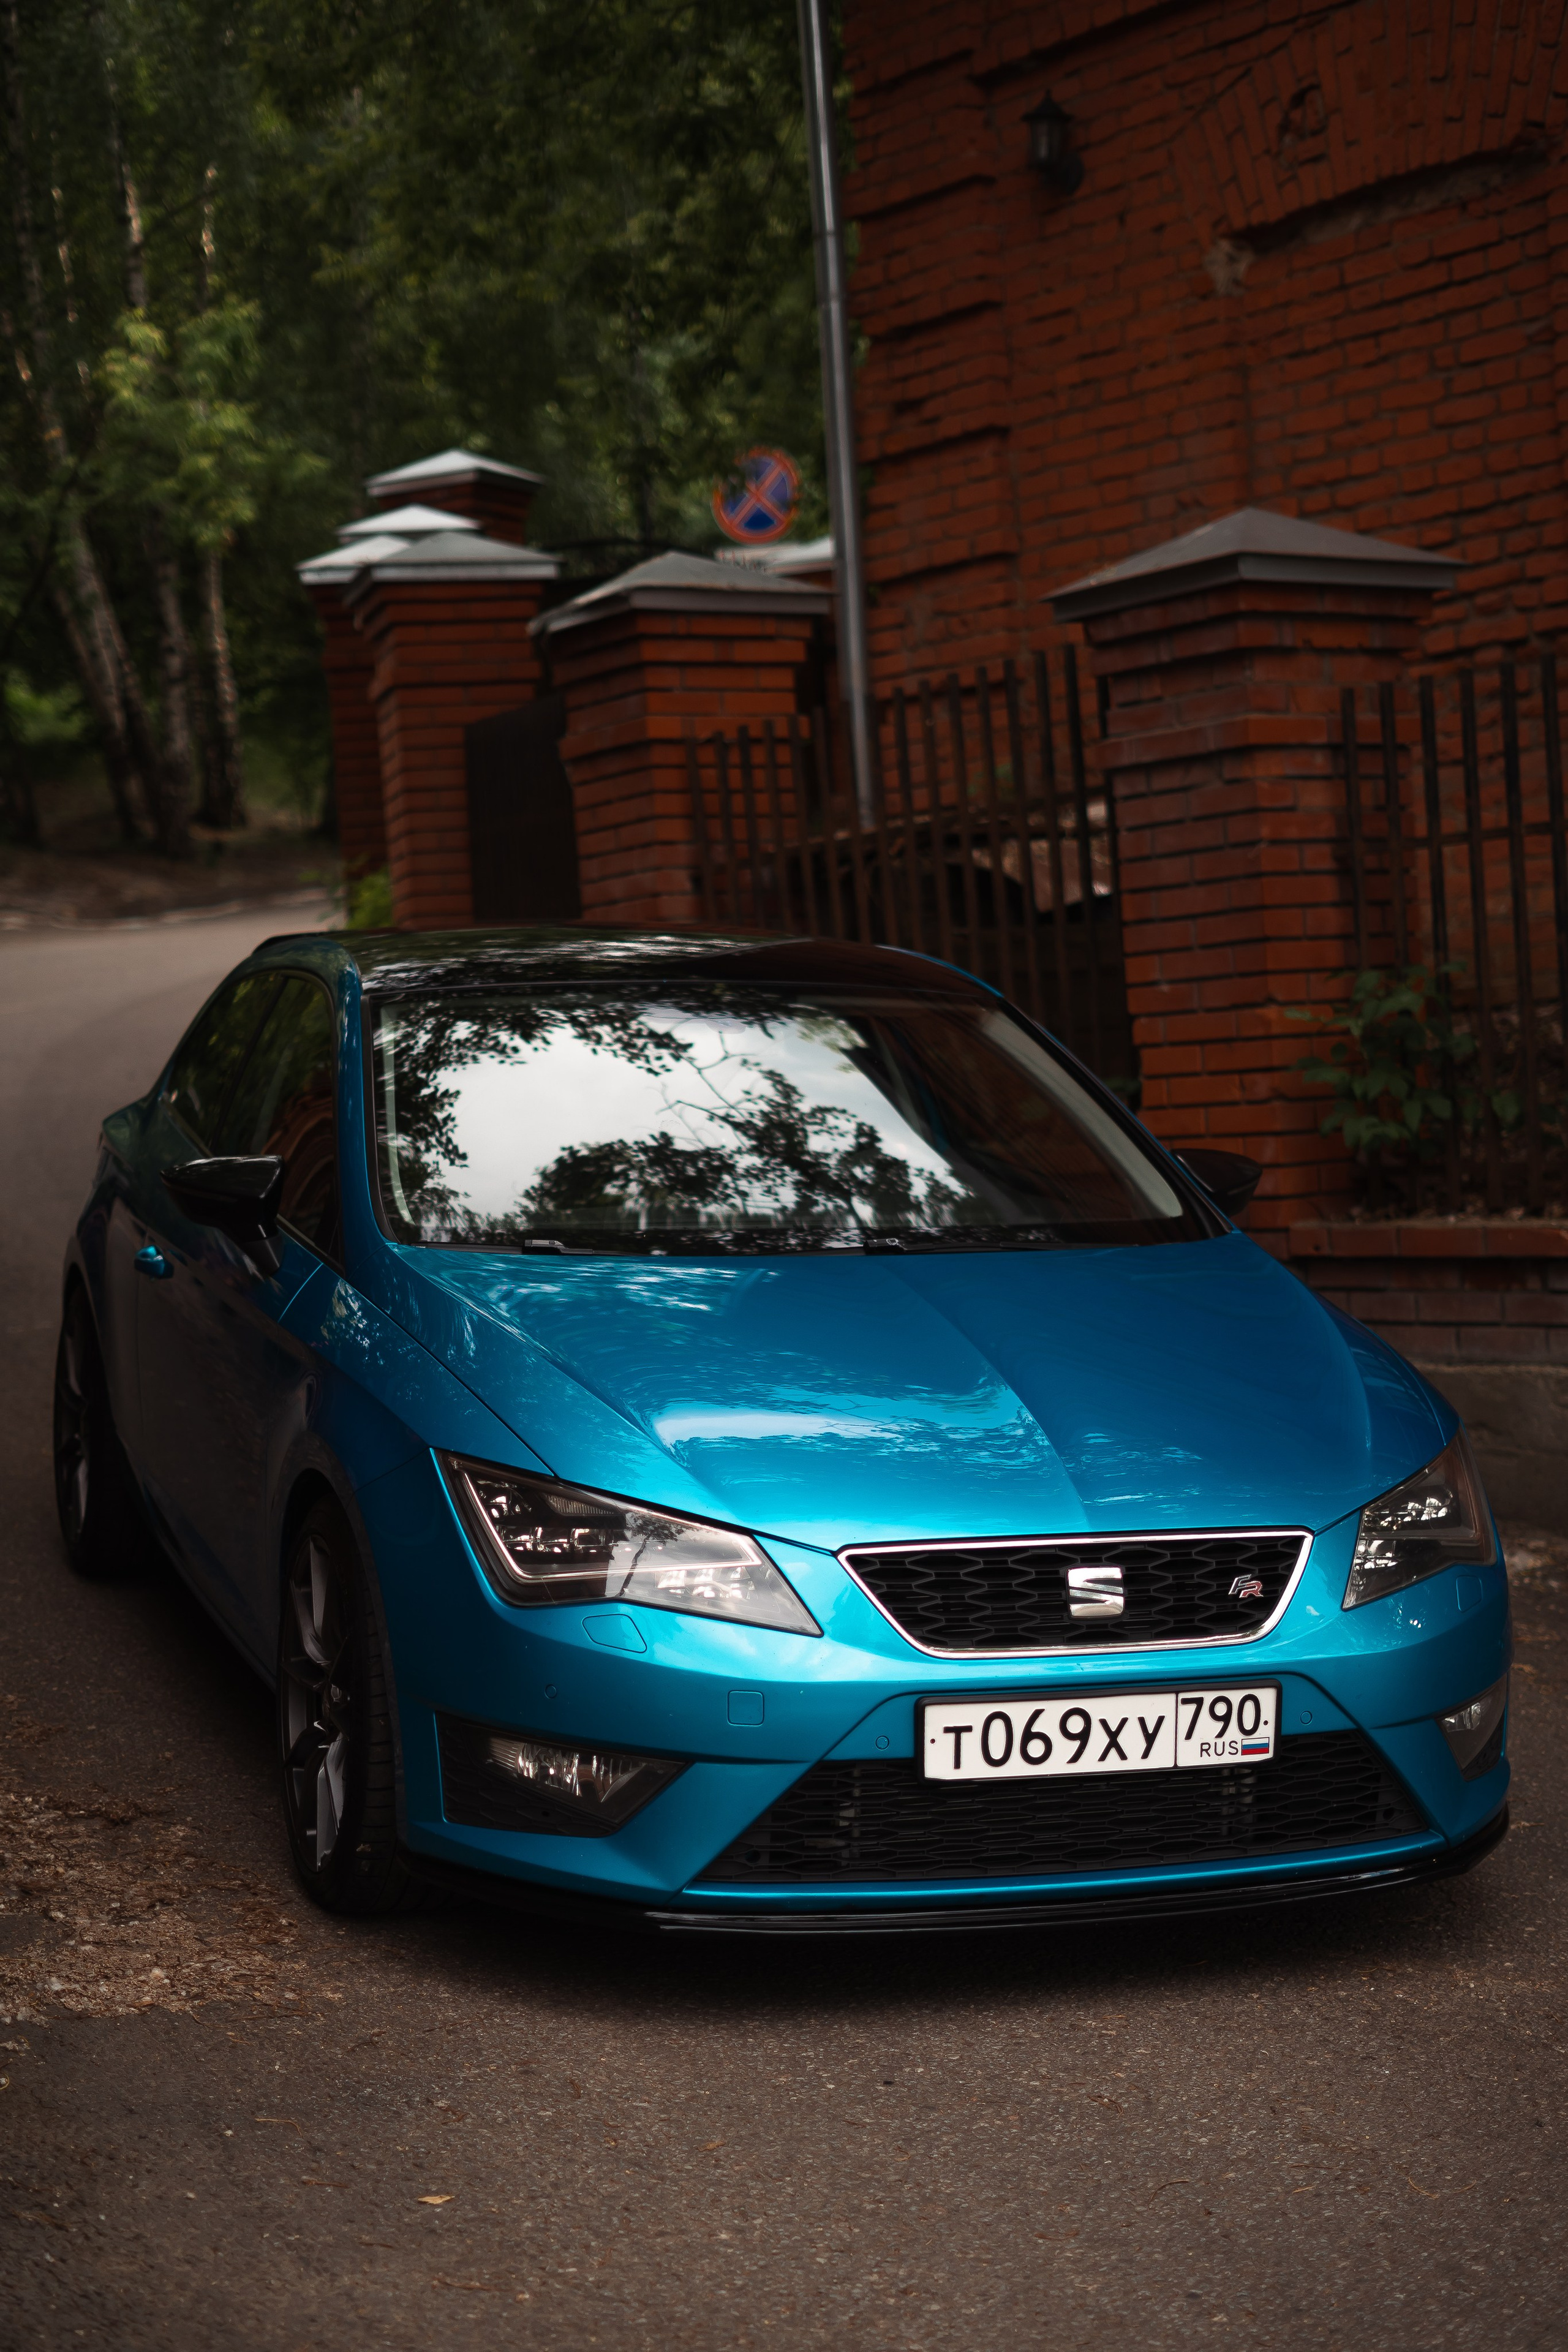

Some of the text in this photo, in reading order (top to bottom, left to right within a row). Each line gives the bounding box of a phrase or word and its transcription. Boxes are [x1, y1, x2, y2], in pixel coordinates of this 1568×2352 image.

[1229, 1575, 1264, 1599] FR
[1181, 1694, 1261, 1740] 790
[1200, 1741, 1238, 1758] RUS
